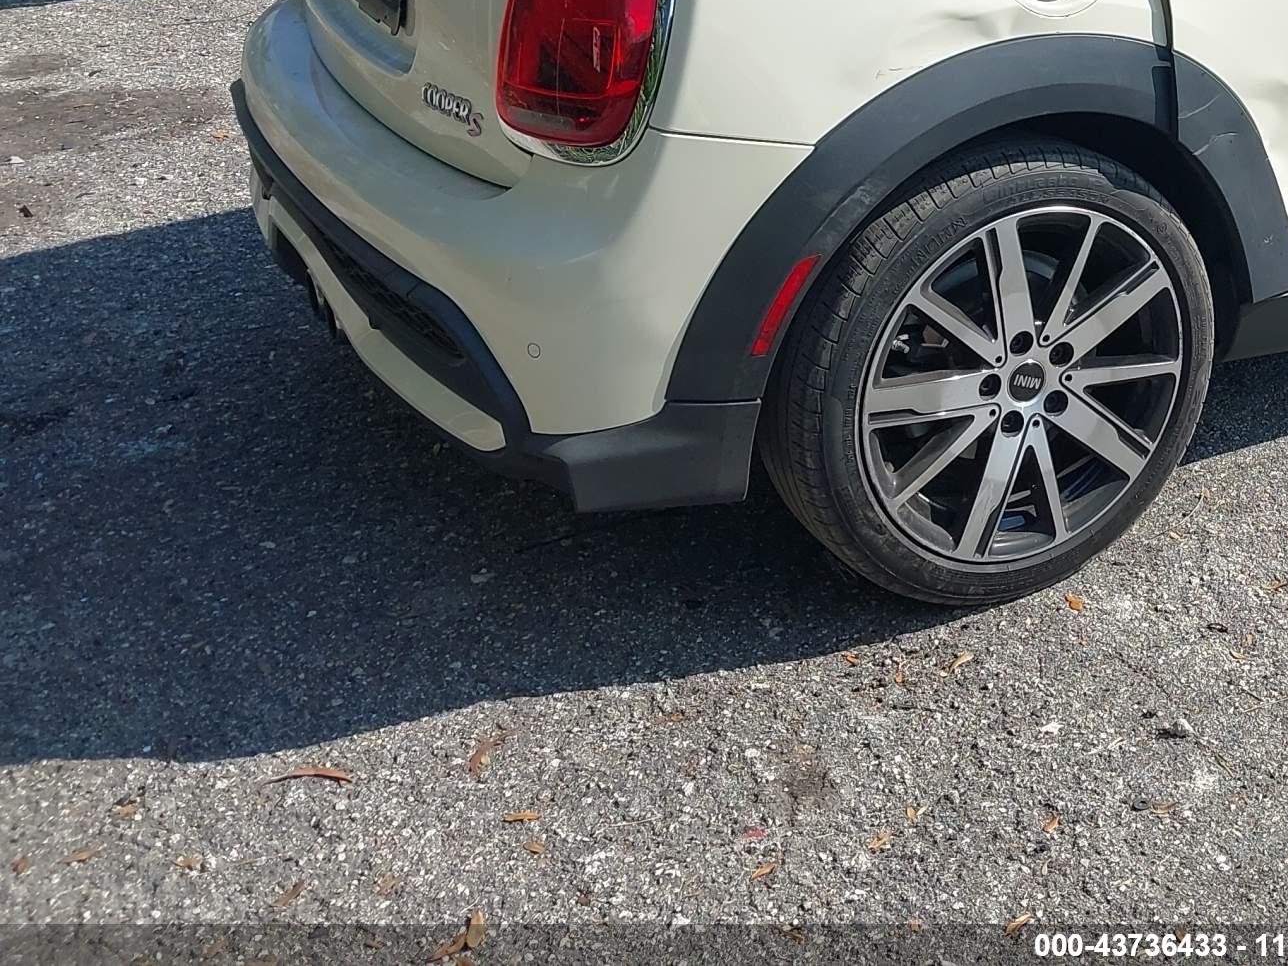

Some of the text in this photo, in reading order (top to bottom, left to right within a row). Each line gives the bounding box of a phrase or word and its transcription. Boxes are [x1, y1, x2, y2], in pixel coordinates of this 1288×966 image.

[421, 81, 485, 137] COOPER S
[1013, 374, 1042, 390] MINI
